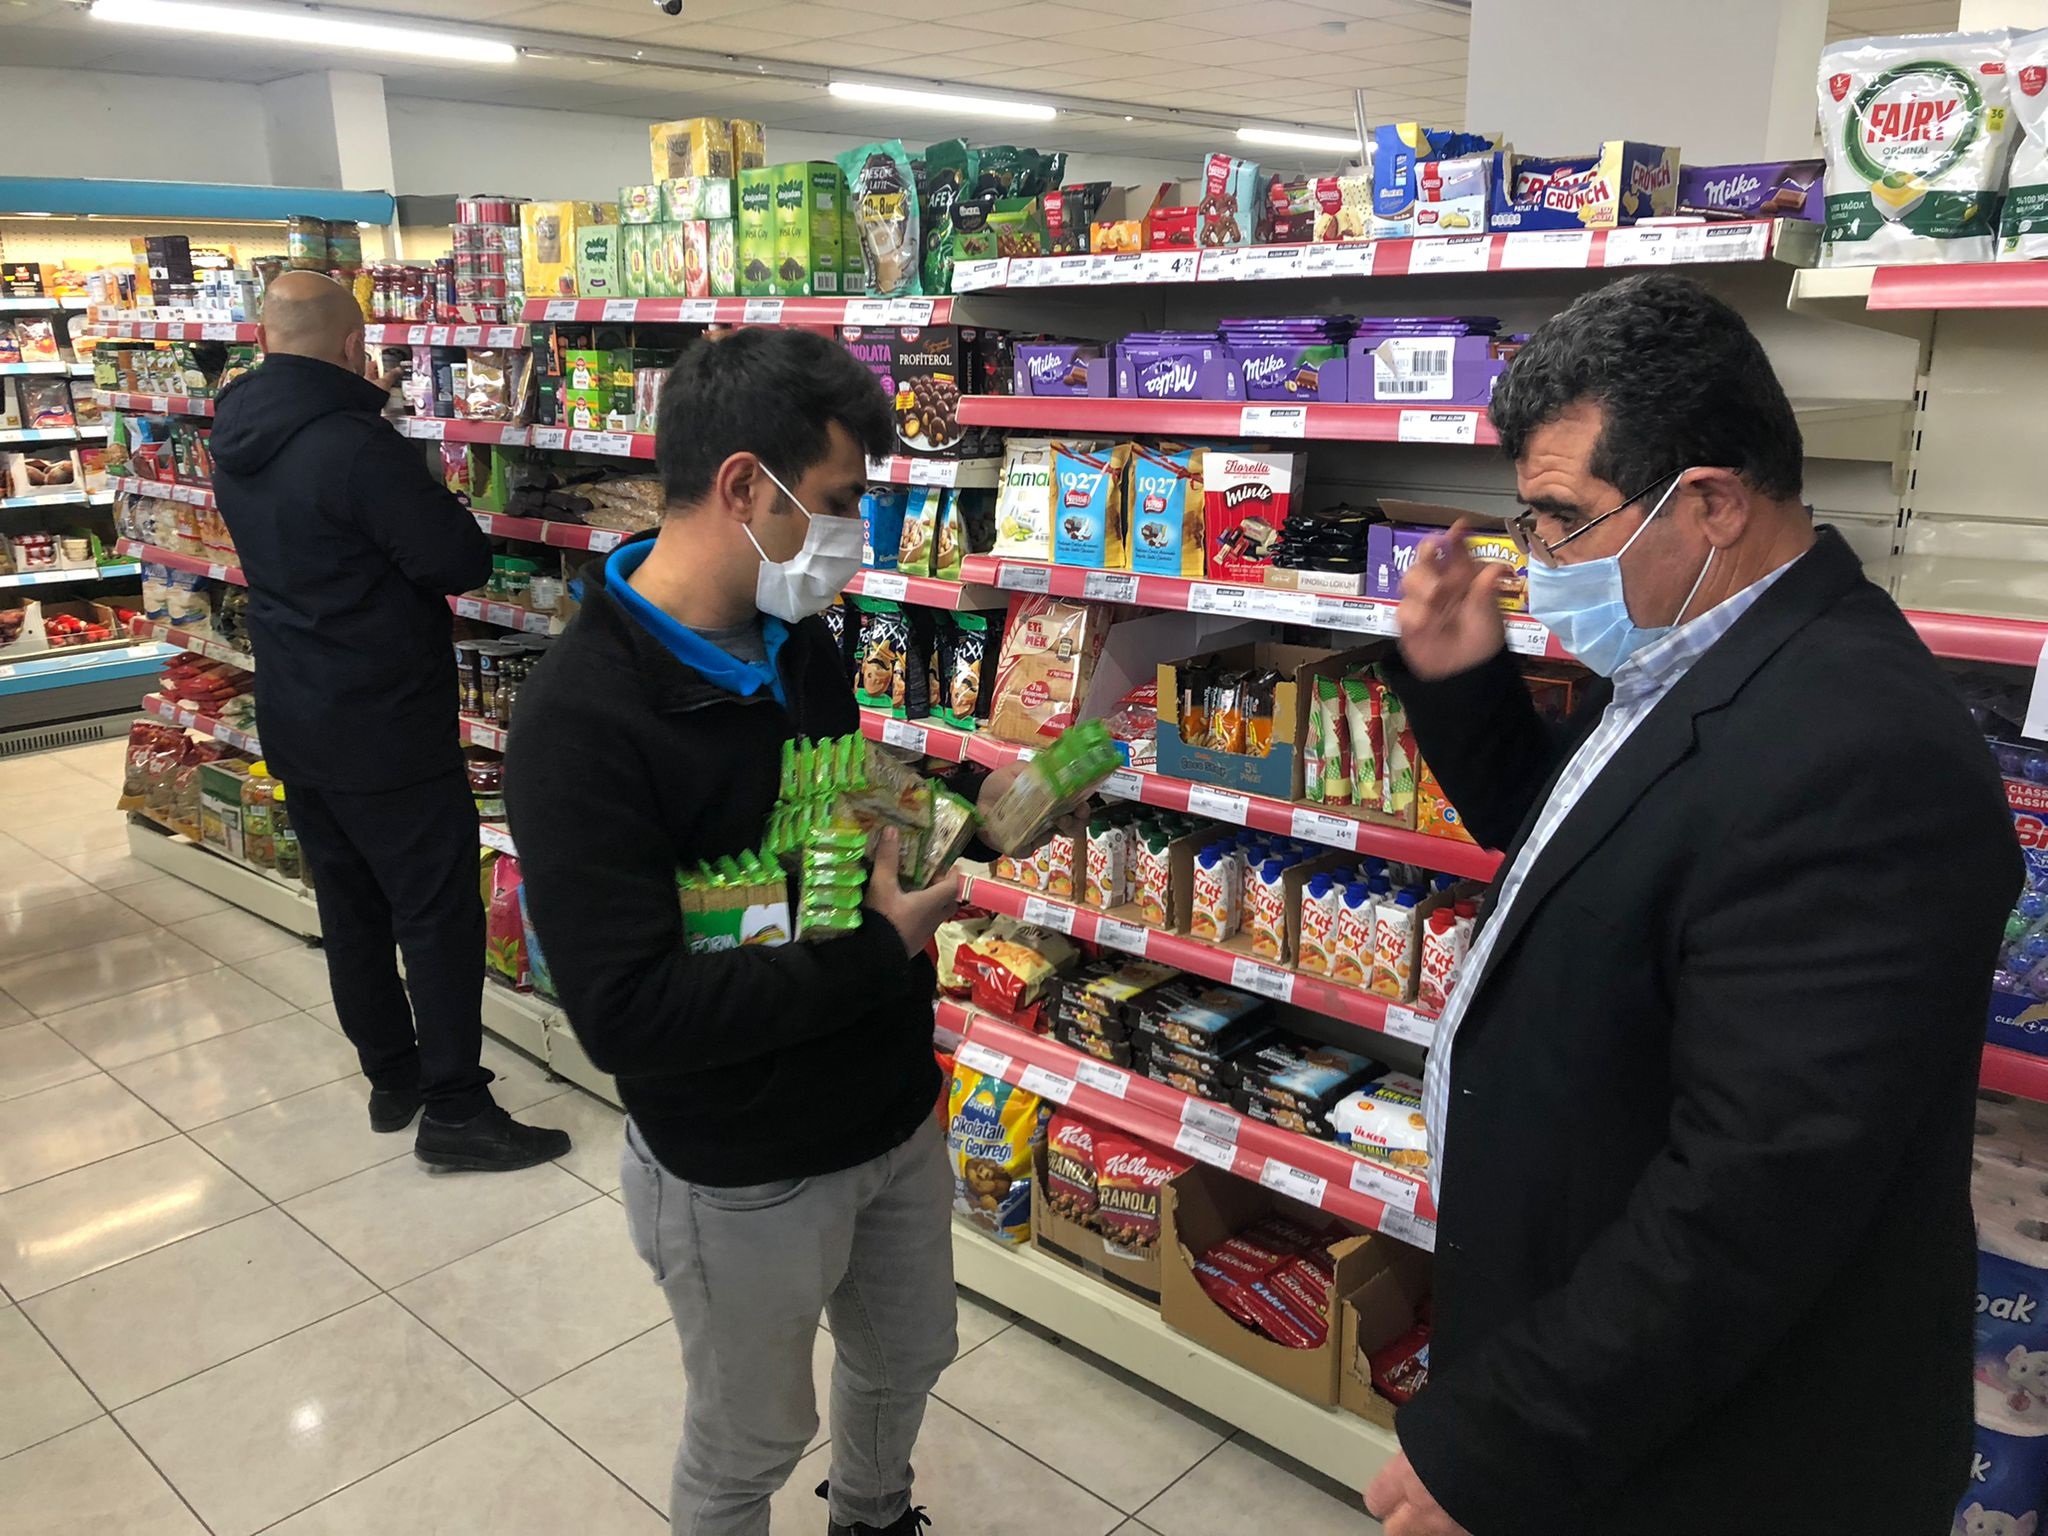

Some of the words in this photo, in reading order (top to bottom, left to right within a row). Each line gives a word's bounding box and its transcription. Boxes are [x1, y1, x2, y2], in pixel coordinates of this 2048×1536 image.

[1866, 97, 1958, 144] FAIRY
[1990, 108, 2004, 119] 36
[1632, 160, 1671, 191] CRUNCH
[1703, 173, 1761, 206] Milka
[1546, 179, 1611, 210] CRUNCH
[1171, 257, 1193, 273] 4,75
[899, 352, 953, 366] PROFİTEROL
[1028, 352, 1062, 377] Milka
[1242, 354, 1286, 381] Milka
[1145, 363, 1197, 397] Milka
[1224, 460, 1270, 474] Fiorella
[1060, 471, 1101, 497] 1927
[1138, 477, 1177, 501] 1927
[1226, 485, 1272, 508] minis
[2007, 794, 2048, 809] LASSI
[1194, 869, 1222, 899] frut
[1255, 885, 1285, 916] frut
[1301, 898, 1333, 932] frut
[1338, 909, 1370, 943] frut
[1375, 919, 1406, 955] frut
[1423, 935, 1455, 971] frut
[951, 1115, 1006, 1140] Çikolatalı
[1354, 1126, 1387, 1146] ÜLKER
[1105, 1153, 1174, 1187] Kellogg's
[1970, 1452, 1992, 1484] k
